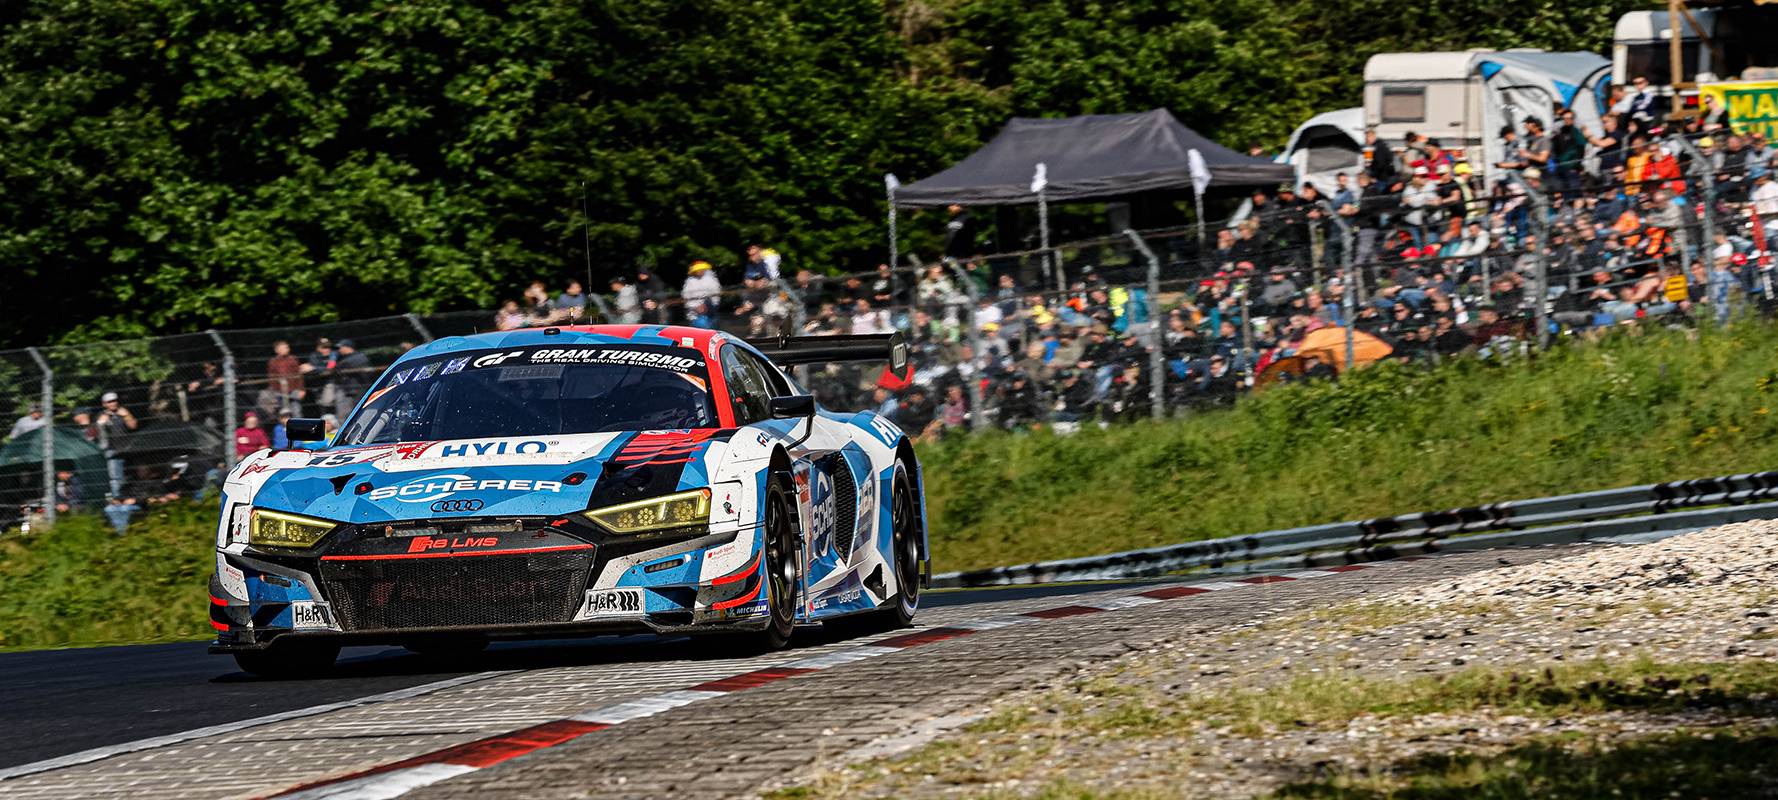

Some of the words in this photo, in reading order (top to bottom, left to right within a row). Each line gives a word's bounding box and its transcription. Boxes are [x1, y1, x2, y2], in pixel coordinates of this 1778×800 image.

[531, 349, 596, 360] GRAN
[598, 350, 696, 368] TURISMO
[583, 357, 625, 365] DRIVING
[628, 360, 689, 373] SIMULATOR
[368, 479, 563, 501] SCHERER
[451, 537, 499, 549] LMS
[588, 592, 617, 612] H&R
[295, 605, 321, 625] H&R
